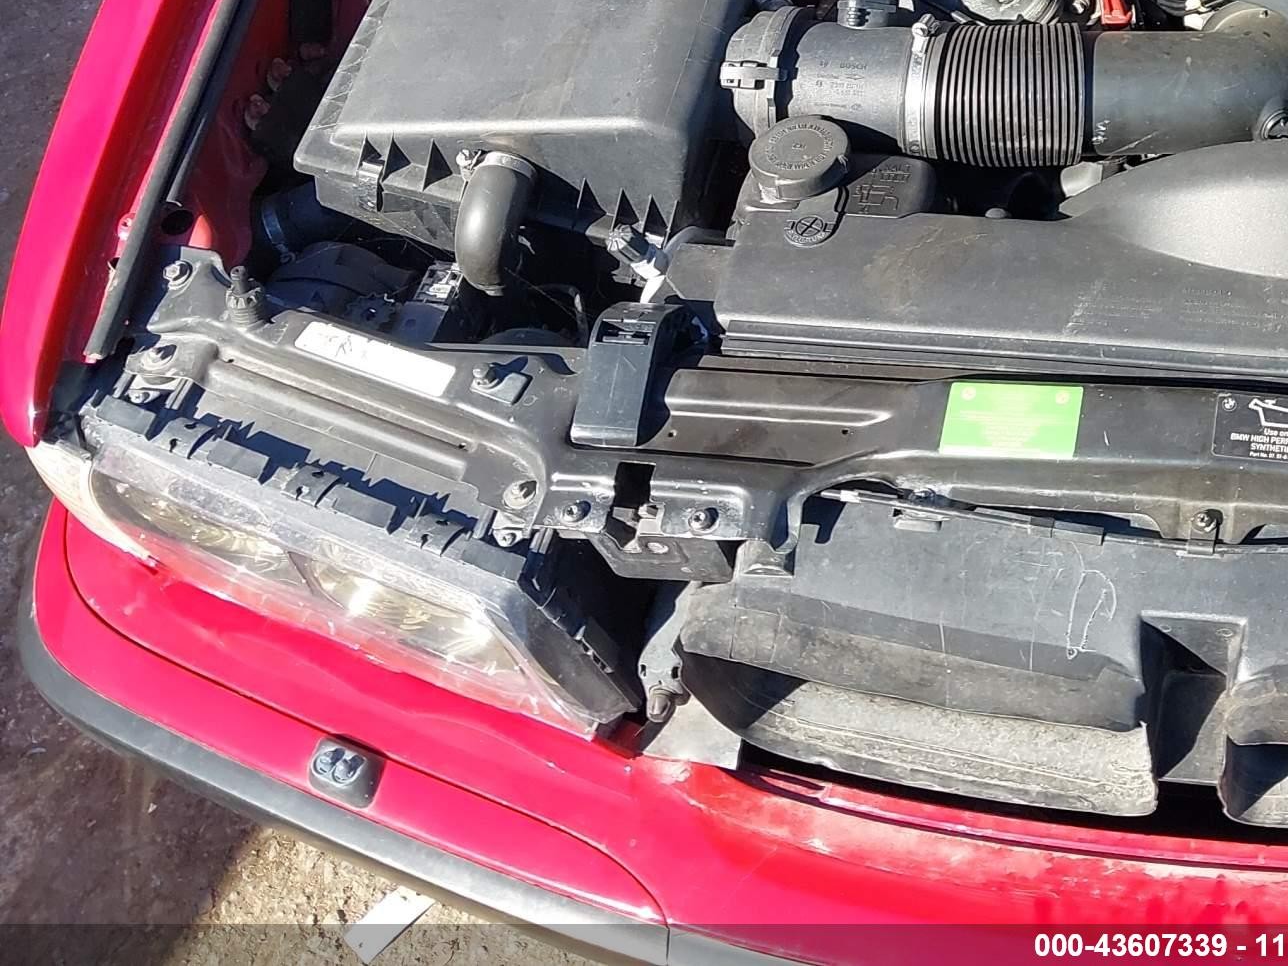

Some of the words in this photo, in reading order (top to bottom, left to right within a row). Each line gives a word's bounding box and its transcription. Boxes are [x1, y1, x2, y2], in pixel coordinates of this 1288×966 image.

[1264, 428, 1278, 436] Use
[1230, 433, 1250, 442] BMW
[1250, 434, 1269, 443] HIGH
